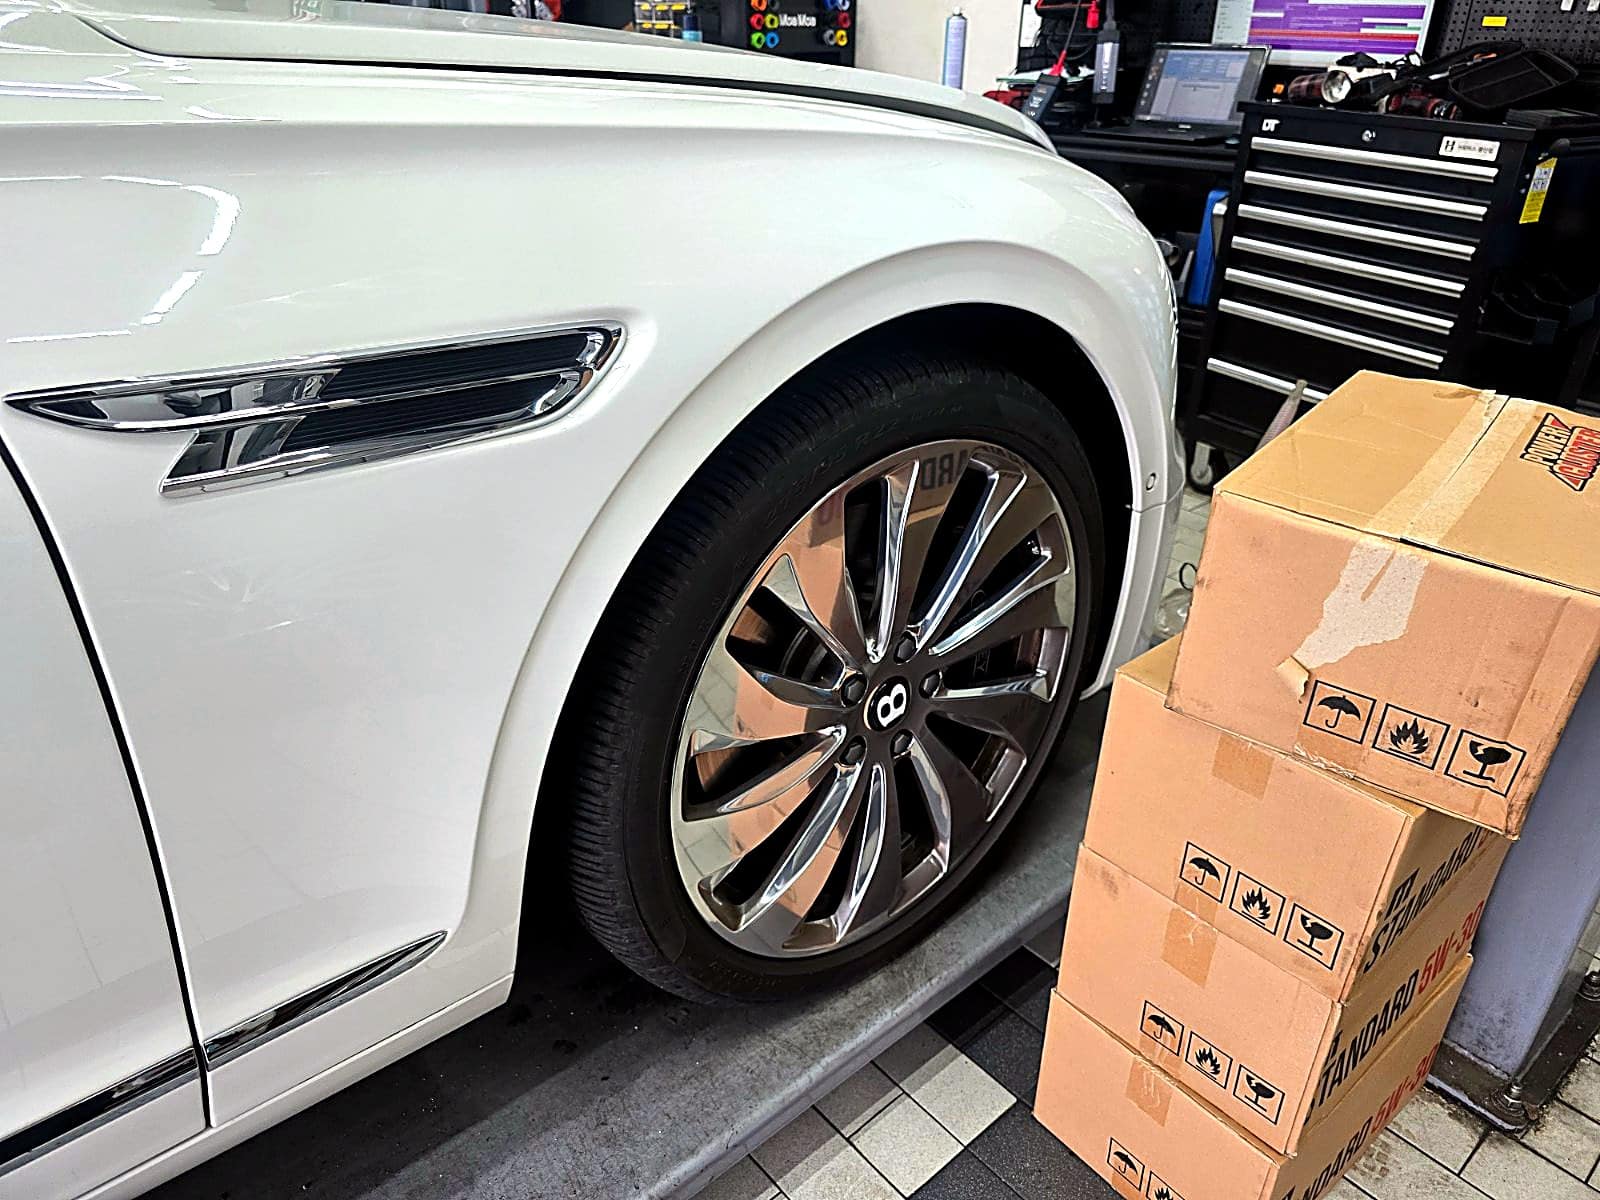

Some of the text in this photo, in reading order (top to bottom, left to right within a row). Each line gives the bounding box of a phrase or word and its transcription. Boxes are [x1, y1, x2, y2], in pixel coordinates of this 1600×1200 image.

[1262, 119, 1281, 132] DT
[1523, 425, 1571, 467] POWER
[877, 683, 907, 727] B
[1363, 825, 1482, 973] STANDARD
[1418, 900, 1485, 994] 5W-30
